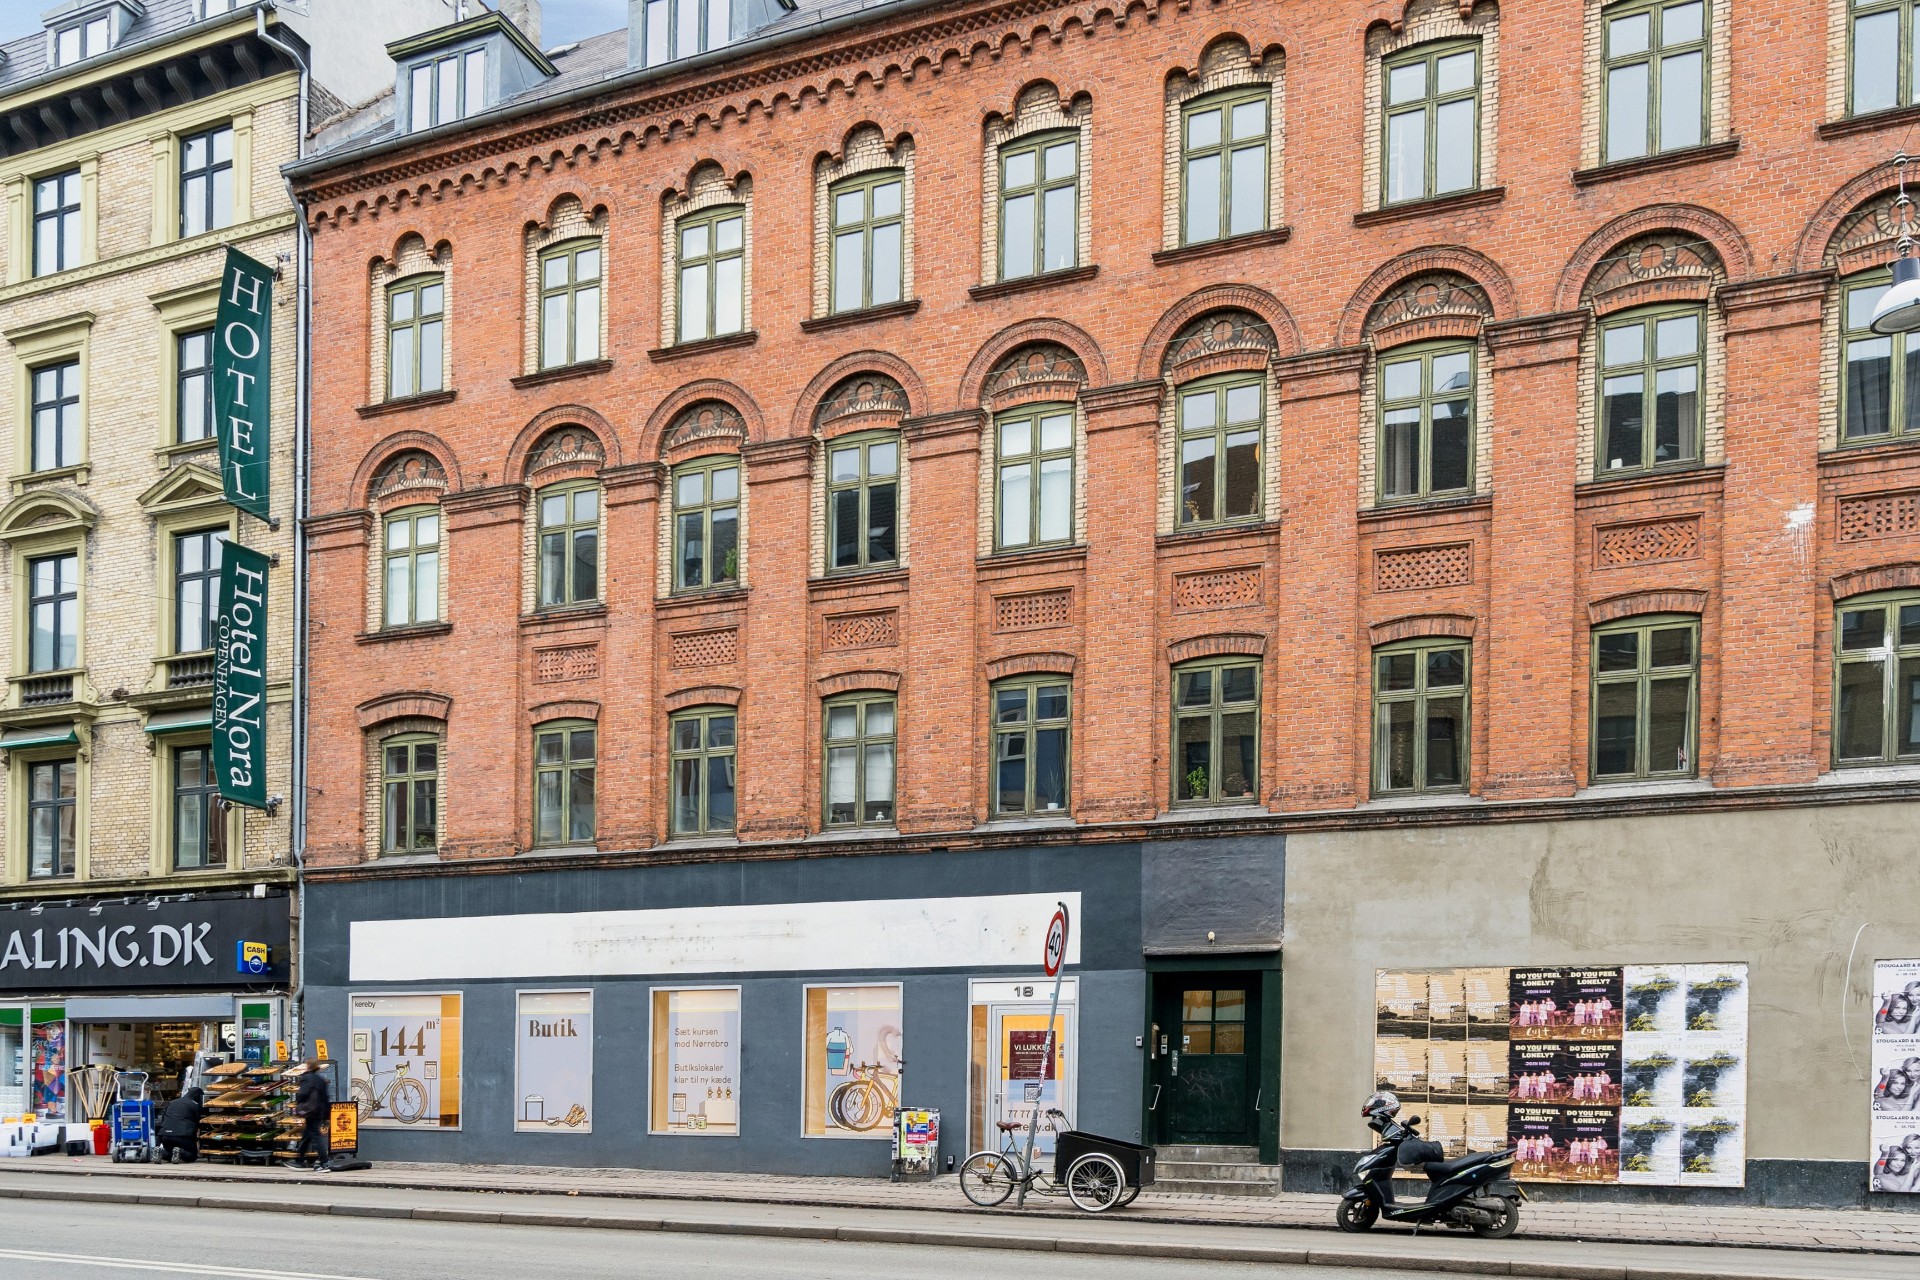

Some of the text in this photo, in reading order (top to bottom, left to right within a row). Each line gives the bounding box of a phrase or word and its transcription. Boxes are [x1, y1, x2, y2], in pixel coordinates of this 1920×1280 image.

[225, 266, 264, 501] HOTEL
[215, 614, 230, 732] COPENHAGEN
[228, 561, 263, 787] Hotel Nora
[0, 921, 214, 971] ALING.DK
[1048, 931, 1062, 957] 40
[246, 946, 266, 954] CASH
[1014, 986, 1034, 997] 18
[354, 1000, 376, 1009] kereby
[529, 1018, 578, 1037] Butik
[674, 1028, 718, 1036] Sæt kursen
[379, 1025, 426, 1056] 144
[674, 1040, 729, 1048] mod Nørrebro
[674, 1064, 724, 1072] Butikslokaler
[674, 1076, 689, 1084] klar
[700, 1077, 709, 1085] ny
[710, 1076, 732, 1084] kæde
[1008, 1110, 1018, 1118] 77
[1020, 1110, 1030, 1118] 77
